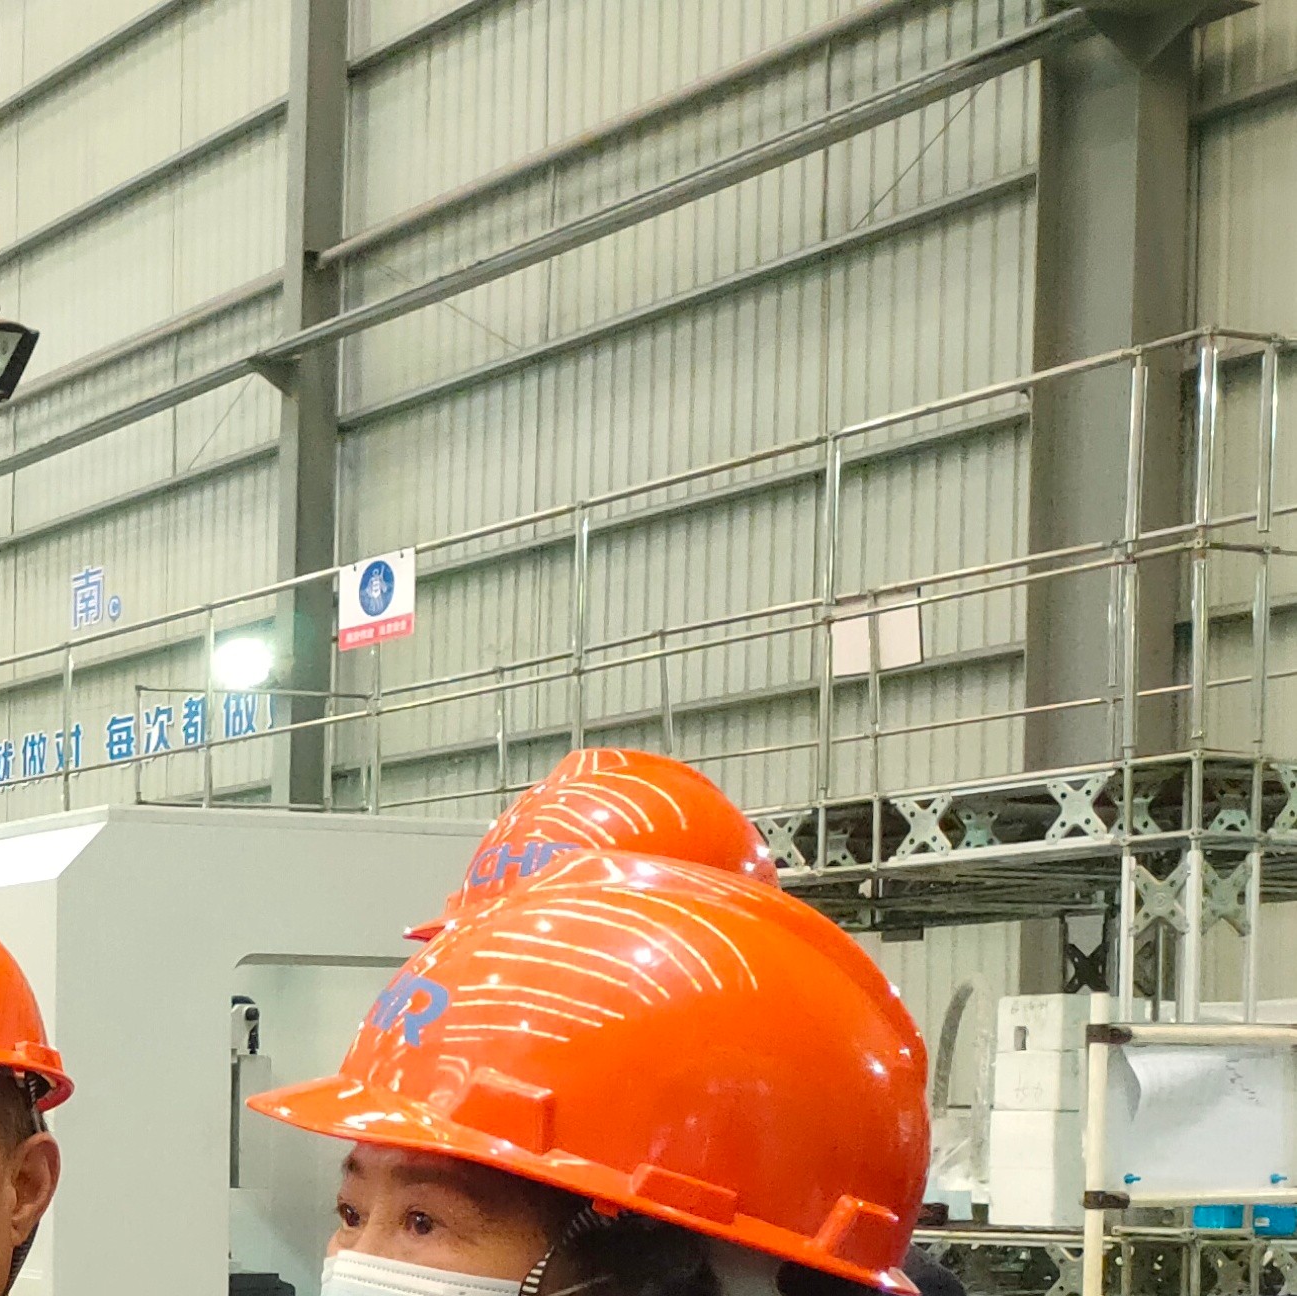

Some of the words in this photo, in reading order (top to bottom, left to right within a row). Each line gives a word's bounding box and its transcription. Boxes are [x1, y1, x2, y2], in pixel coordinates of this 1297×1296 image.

[71, 567, 104, 629] 南
[105, 690, 273, 762] 每次都做
